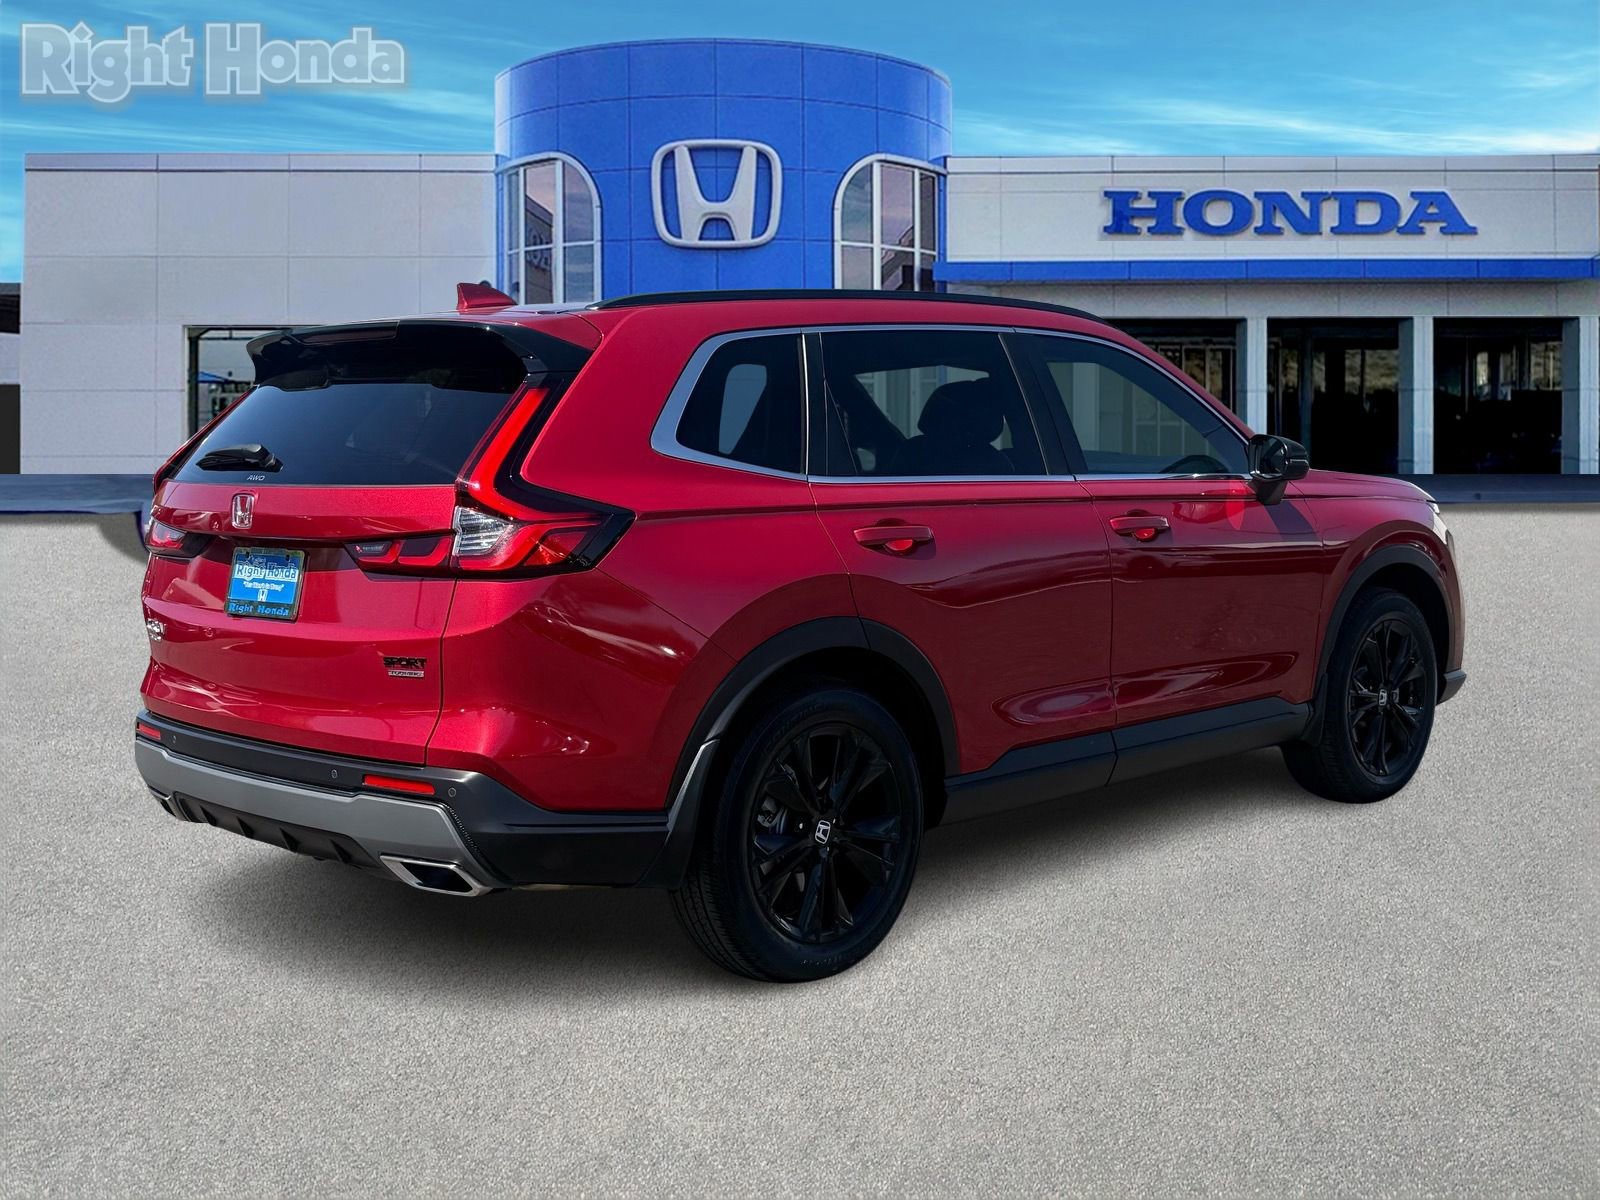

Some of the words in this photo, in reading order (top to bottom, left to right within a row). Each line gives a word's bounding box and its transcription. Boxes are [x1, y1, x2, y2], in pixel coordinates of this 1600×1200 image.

[1103, 189, 1478, 236] HONDA
[234, 561, 266, 580] Right
[266, 562, 299, 582] Honda
[228, 602, 254, 614] Right
[257, 605, 290, 617] Honda
[383, 656, 427, 669] SPORT
